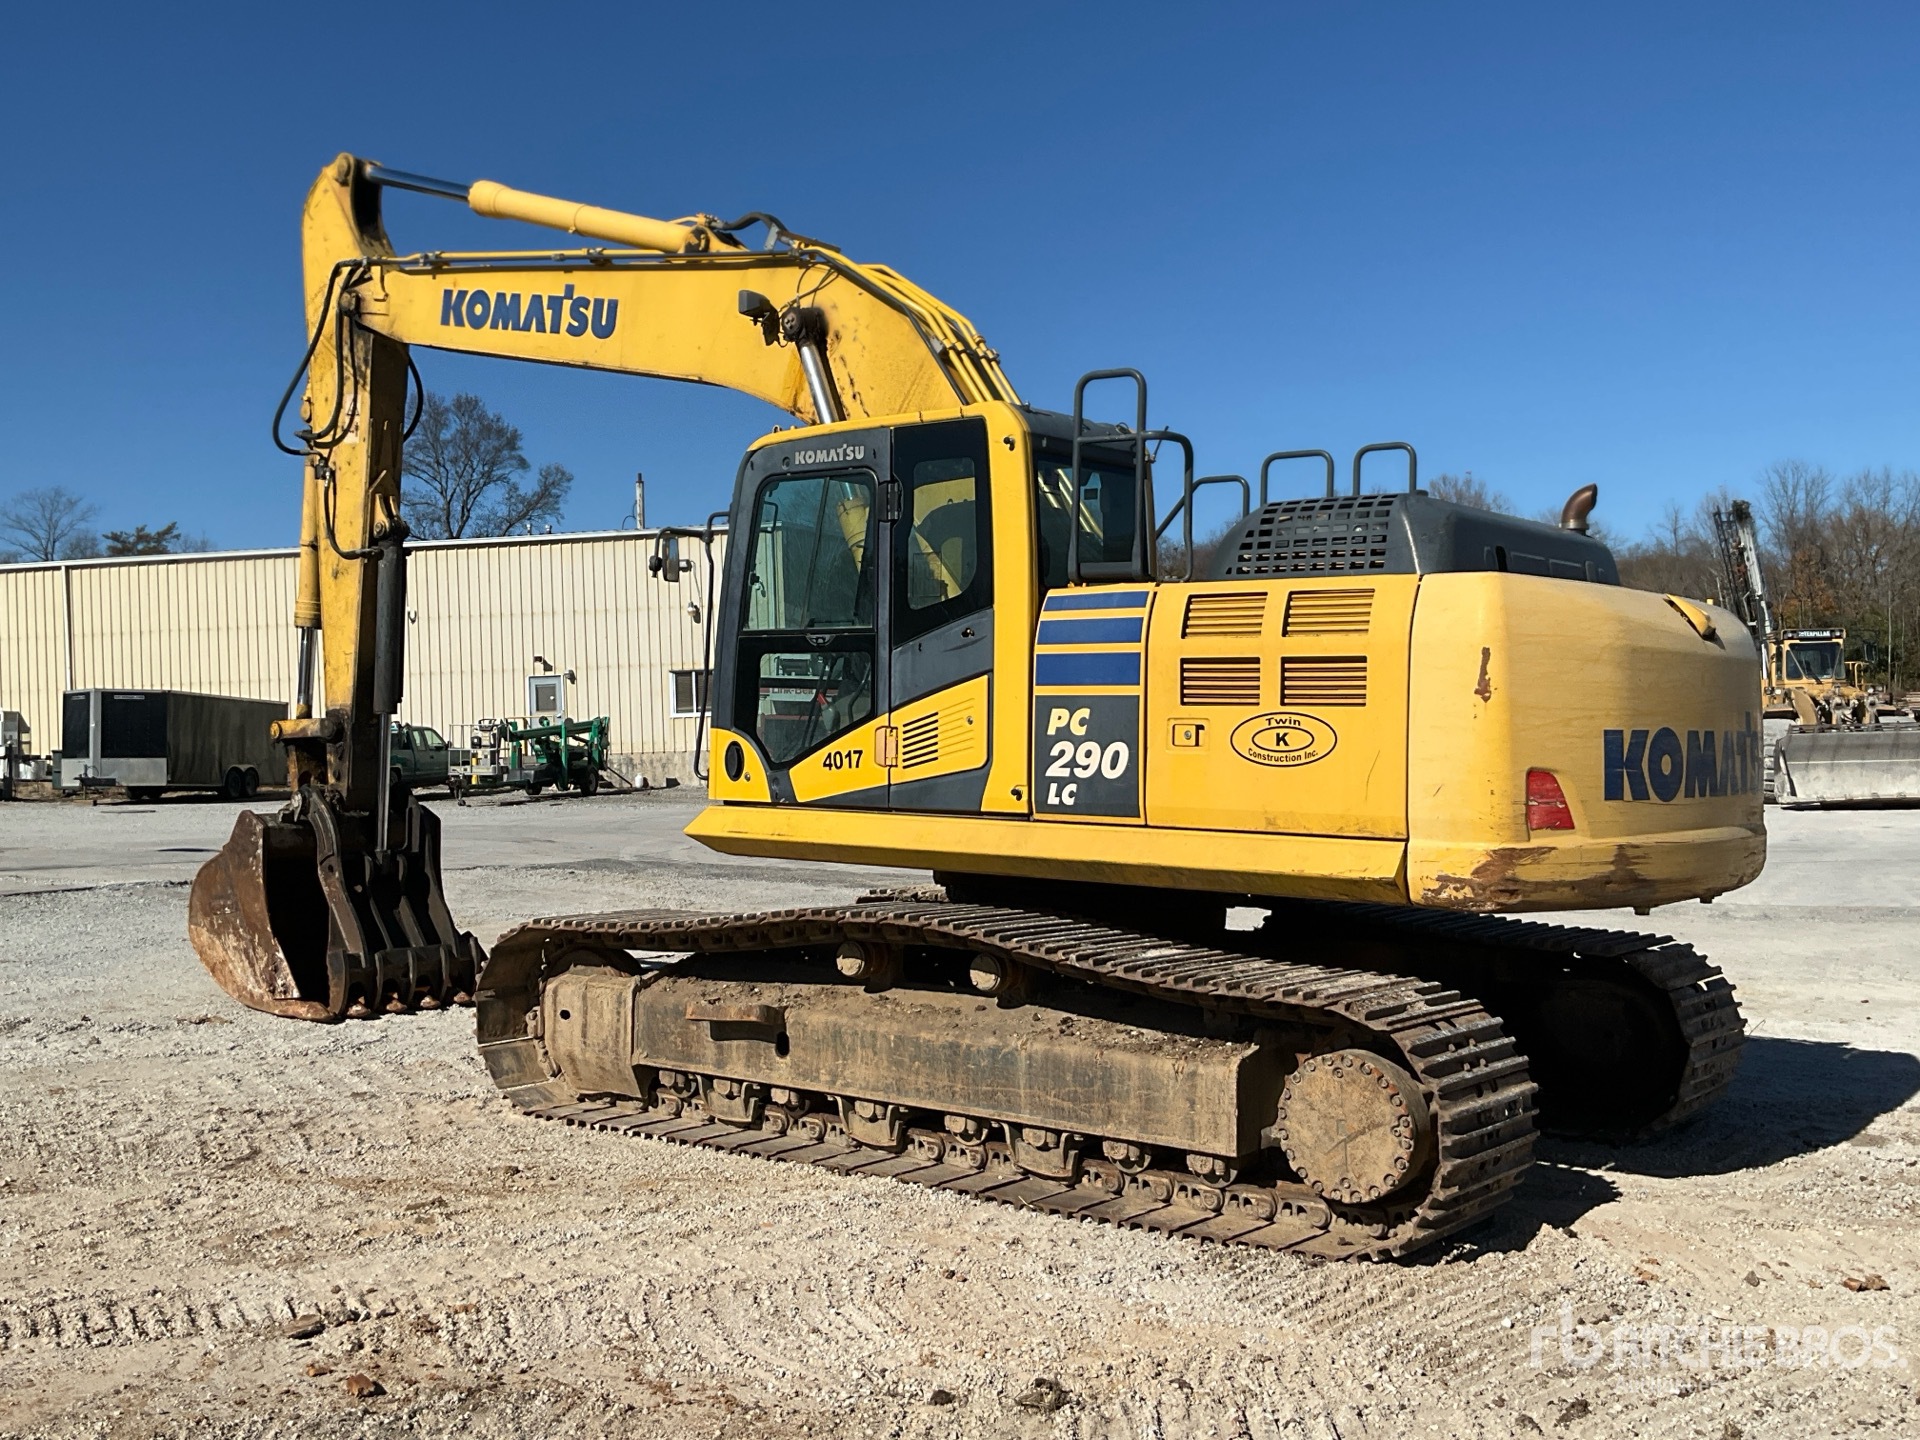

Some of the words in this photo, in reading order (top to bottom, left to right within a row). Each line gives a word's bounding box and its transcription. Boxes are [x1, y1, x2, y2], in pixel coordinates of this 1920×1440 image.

[440, 283, 619, 340] KOMATSU
[794, 443, 865, 465] KOMATSU
[1047, 707, 1090, 736] PC
[1265, 716, 1301, 726] Twin
[1275, 732, 1290, 747] K
[823, 750, 863, 770] 4017
[1045, 741, 1129, 779] 290
[1248, 747, 1302, 763] Construction
[1304, 749, 1319, 760] Inc.
[1047, 782, 1077, 806] LC
